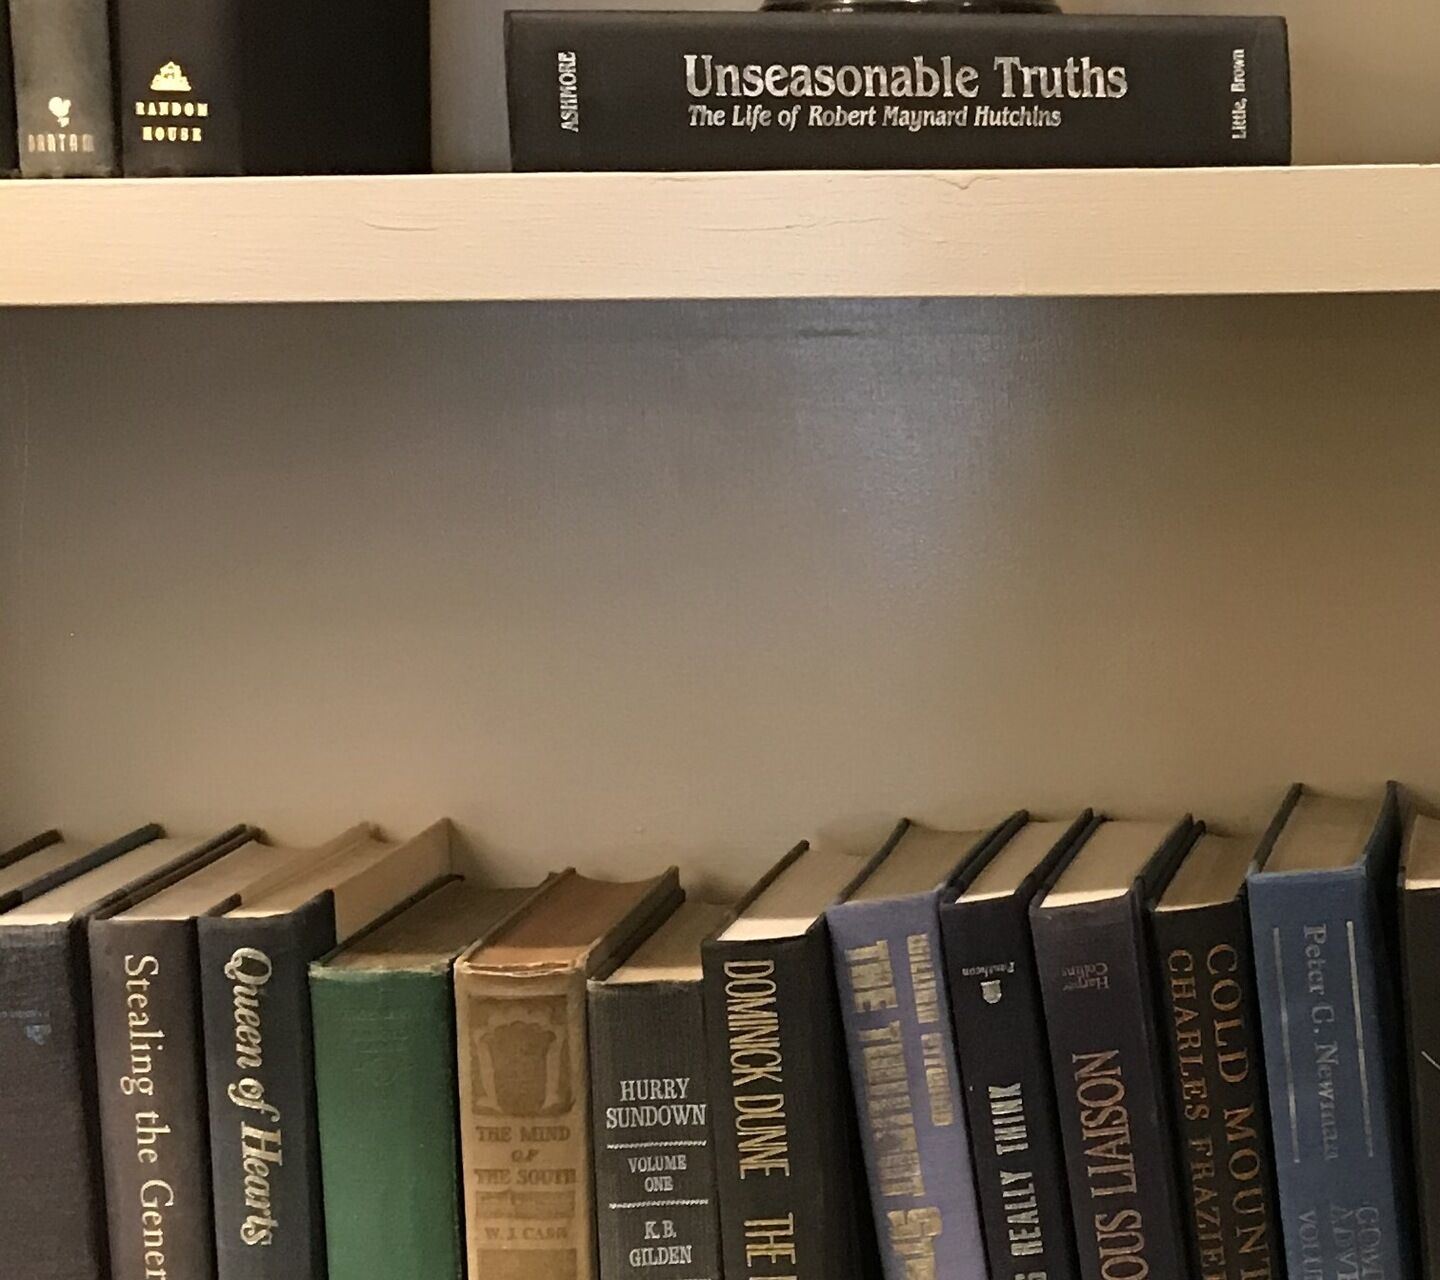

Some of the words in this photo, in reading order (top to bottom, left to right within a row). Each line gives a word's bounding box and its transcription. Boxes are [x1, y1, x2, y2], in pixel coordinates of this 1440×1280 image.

[134, 102, 209, 117] RANDOM
[558, 51, 580, 134] ASHMORE
[684, 53, 980, 100] Unseasonable
[992, 55, 1129, 100] Truths
[141, 126, 202, 142] HOUSE
[688, 104, 726, 129] The
[731, 104, 772, 129] Life
[776, 106, 801, 132] of
[808, 105, 878, 129] Robert
[881, 106, 968, 132] Maynard
[973, 105, 1062, 128] Hutchins
[120, 953, 166, 1096] Stealing
[224, 946, 272, 1069] Queen
[722, 958, 783, 1087] DOMINICK
[1167, 948, 1211, 1121] CHARLES
[1205, 942, 1250, 1084] COLD
[227, 1077, 281, 1122] of
[604, 1103, 707, 1130] SUNDOWN
[618, 1076, 691, 1103] HURRY
[987, 1082, 1030, 1156] THINK
[1071, 1048, 1137, 1199] LIAISON
[133, 1111, 170, 1163] the
[627, 1153, 688, 1174] VOLUME
[732, 1093, 791, 1180] DUNNE
[240, 1121, 283, 1246] Hearts
[999, 1170, 1045, 1257] REALLY
[743, 1212, 797, 1267] THE
